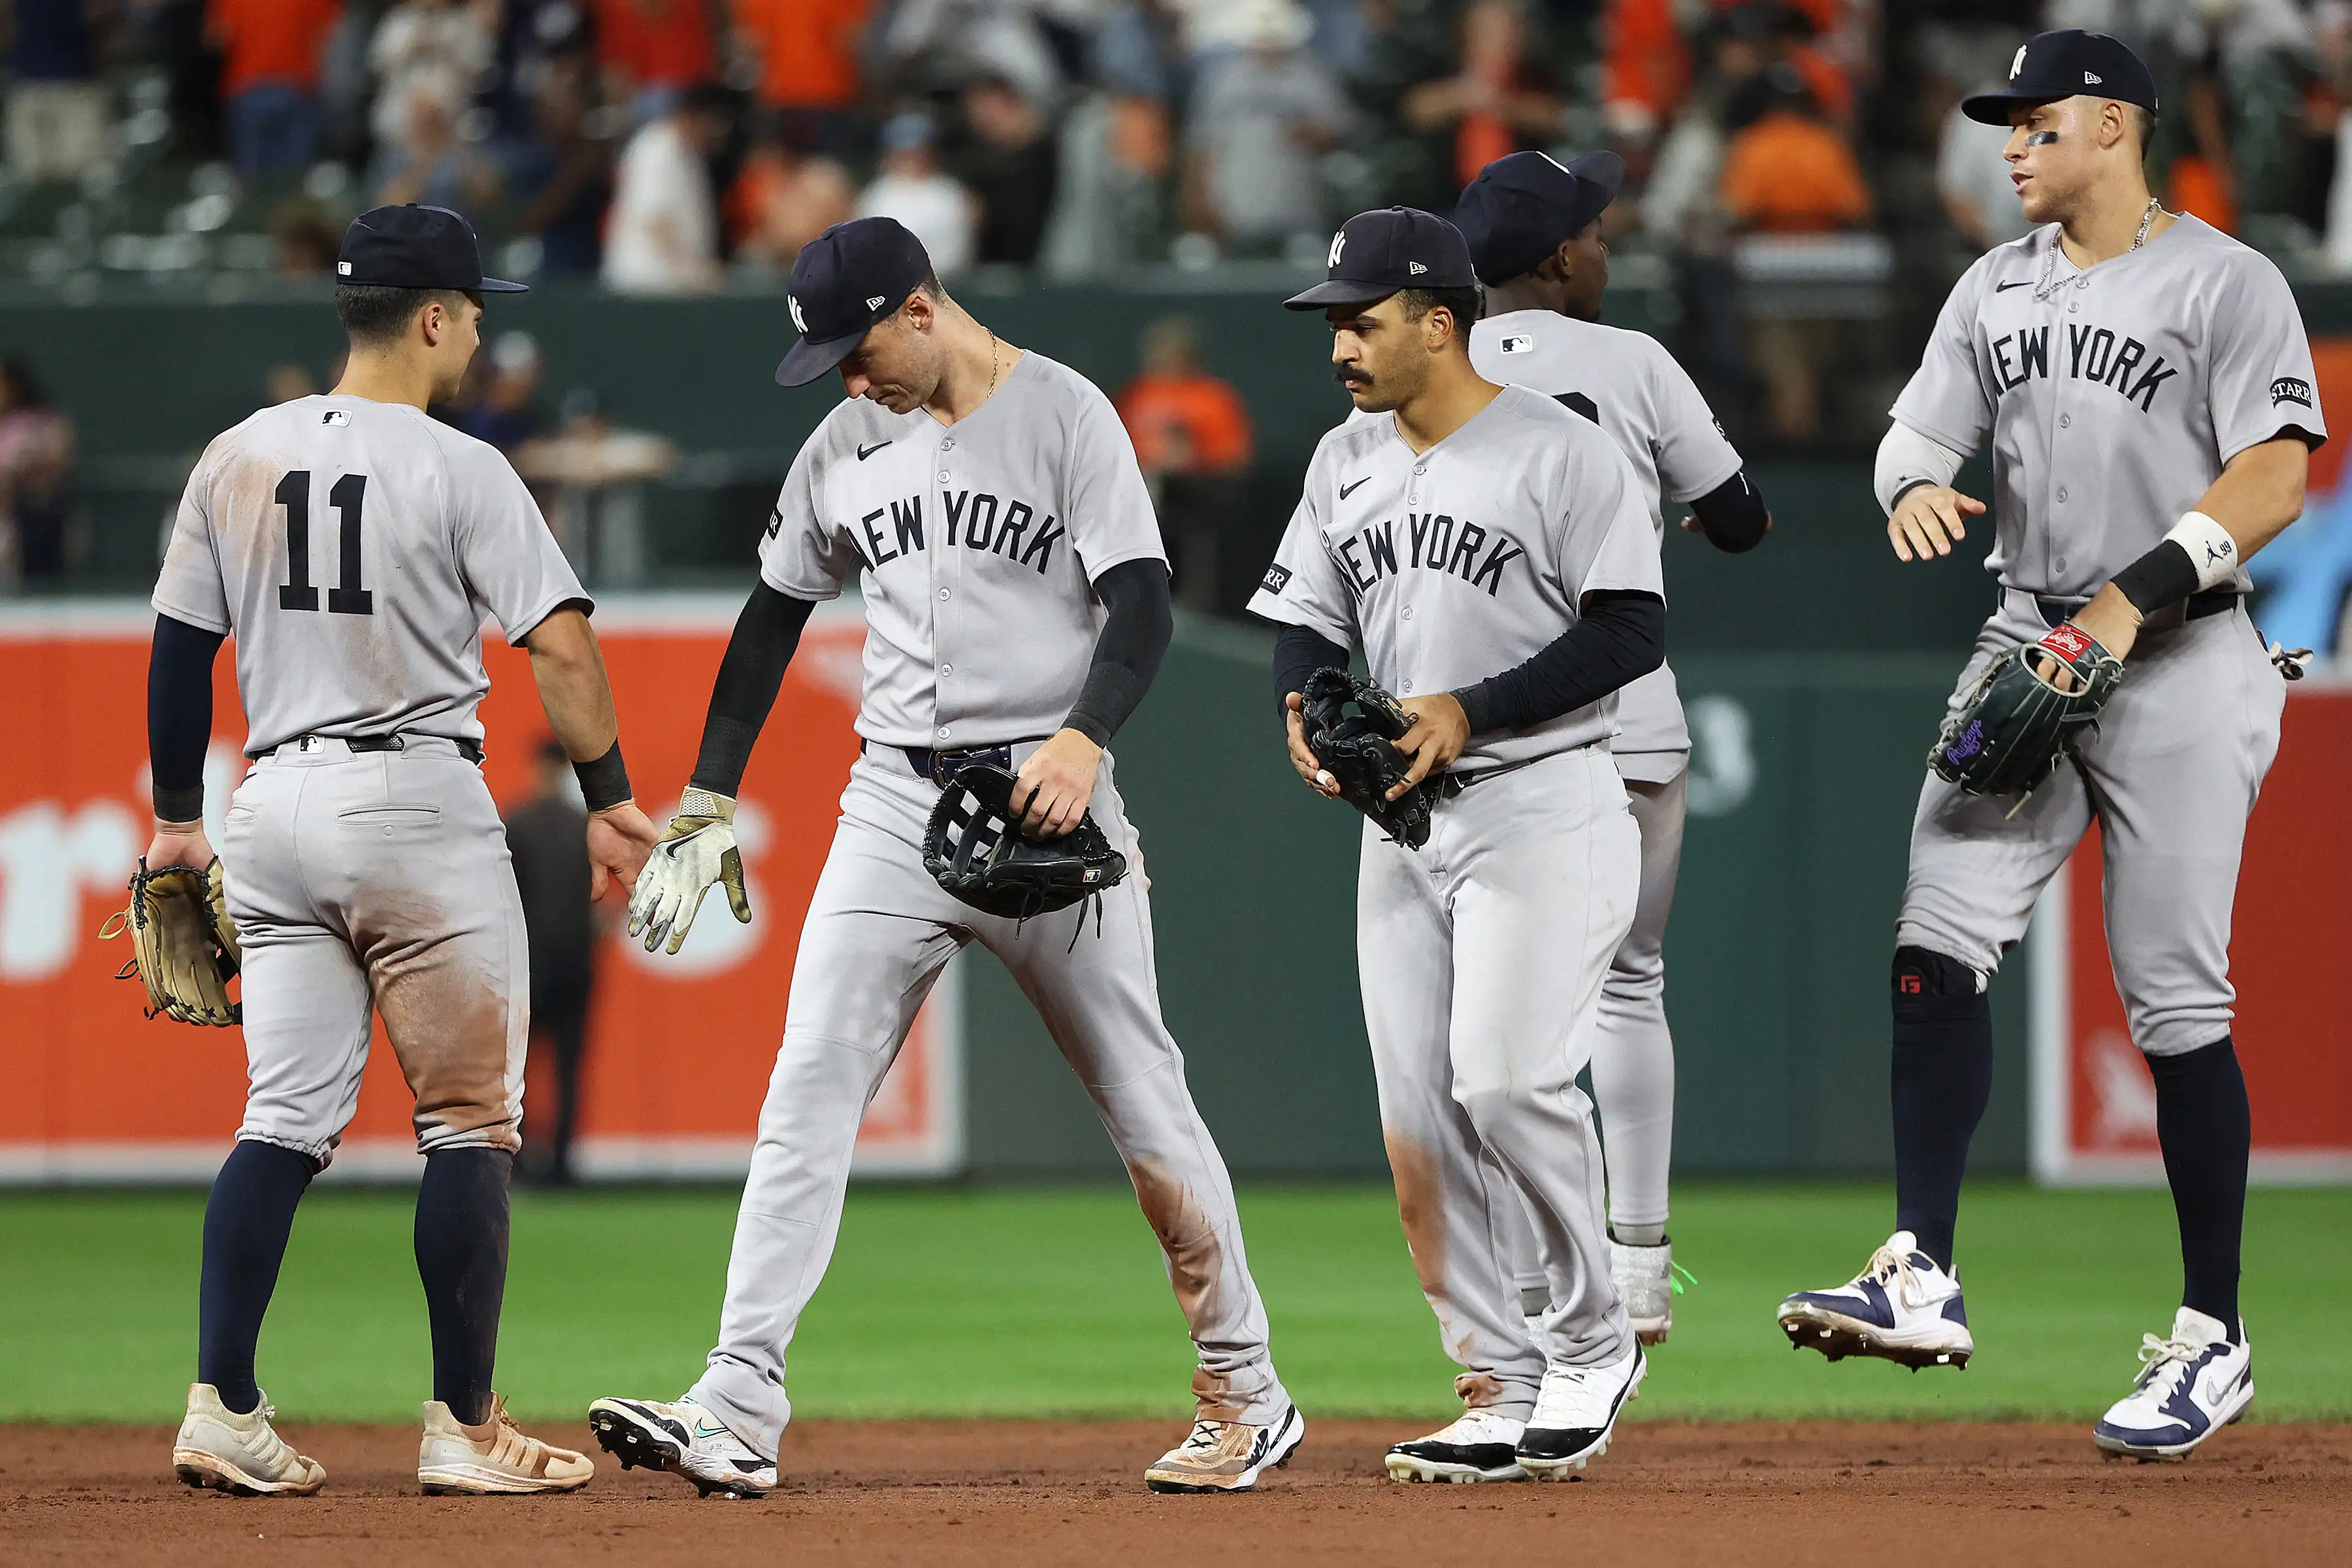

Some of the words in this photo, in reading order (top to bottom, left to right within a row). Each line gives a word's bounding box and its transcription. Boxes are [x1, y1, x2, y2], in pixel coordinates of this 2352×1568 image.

[1993, 325, 2049, 397] EW
[2069, 323, 2178, 414] YORK
[2271, 382, 2311, 403] STARR
[274, 470, 374, 615] 11
[943, 490, 1066, 575] YORK
[1409, 513, 1524, 597] YORK
